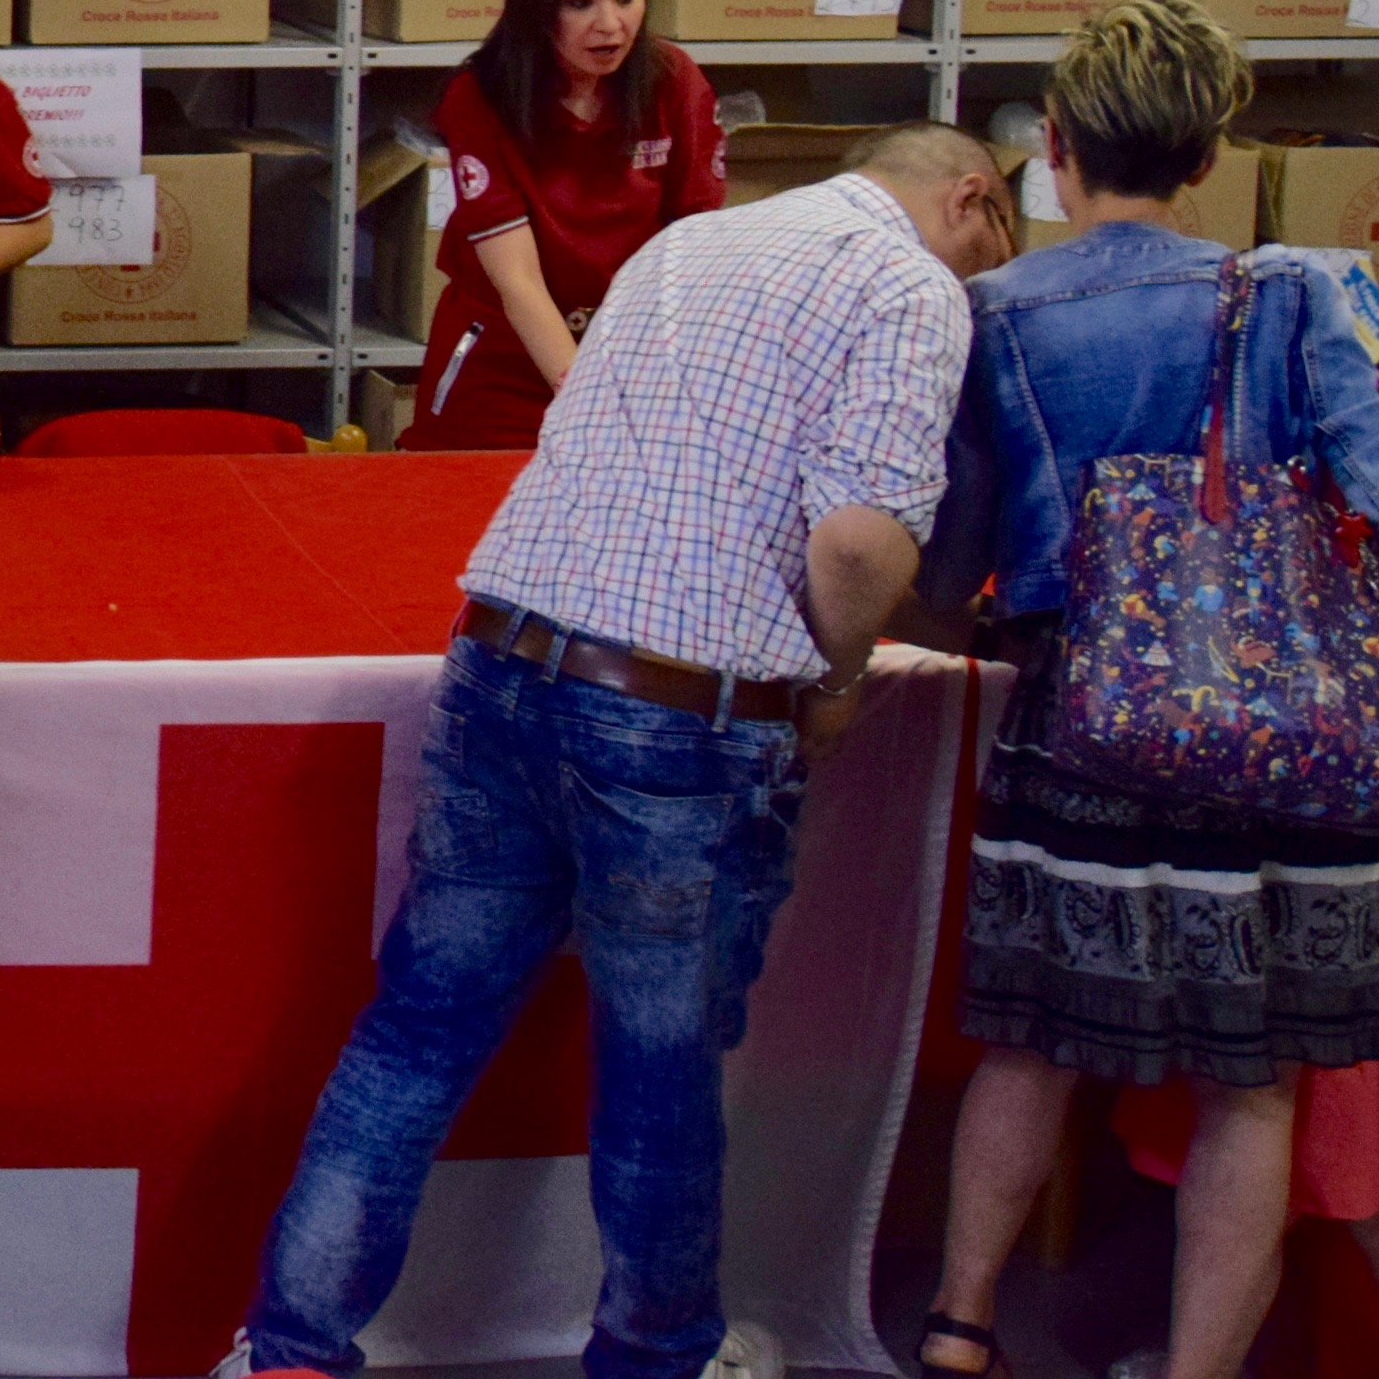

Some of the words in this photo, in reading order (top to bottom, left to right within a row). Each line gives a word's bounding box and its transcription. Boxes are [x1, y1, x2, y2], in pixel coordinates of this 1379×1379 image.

[725, 6, 762, 17] Croce
[766, 6, 804, 17] Rossa
[22, 86, 92, 100] BIGLIETTO
[68, 218, 124, 243] 983
